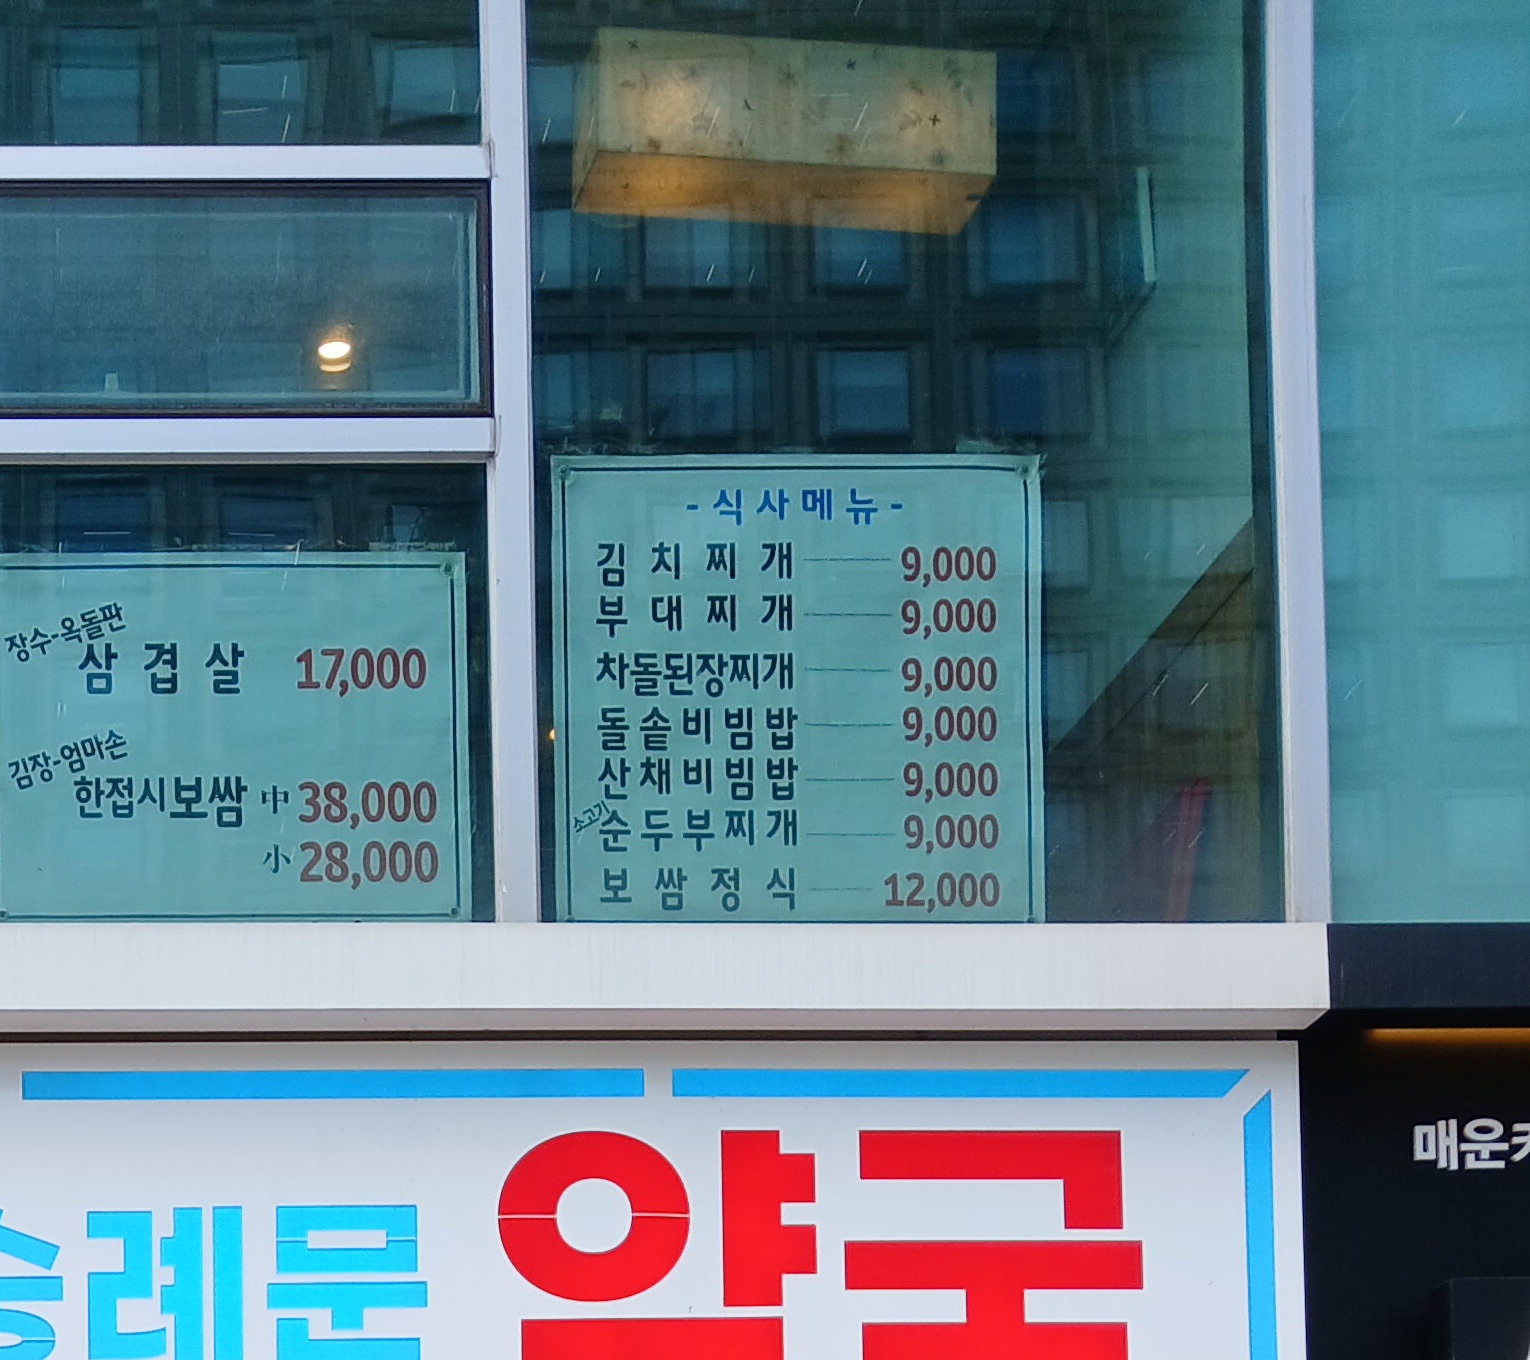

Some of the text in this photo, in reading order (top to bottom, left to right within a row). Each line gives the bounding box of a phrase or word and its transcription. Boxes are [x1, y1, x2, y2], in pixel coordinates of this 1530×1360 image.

[596, 542, 997, 588] 김치찌개 9,000
[4, 601, 127, 663] 장수-옥돌판
[596, 594, 997, 640] 부대찌개 9,000
[78, 642, 427, 697] 삼겹살 17,000
[596, 651, 998, 697] 차돌된장찌개 9,000
[597, 705, 998, 752] 돌솥비빔밥 9,000
[8, 728, 129, 790] 김장-엄마손
[598, 756, 999, 802] 산채비빔밥 9,000
[72, 775, 437, 830] 한접시보쌈 中 38,000
[573, 800, 611, 832] 소고기
[598, 808, 999, 855] 순두부찌개 9,000
[262, 840, 439, 889] 小 28,000
[600, 867, 1000, 913] 보쌈정식 12,000
